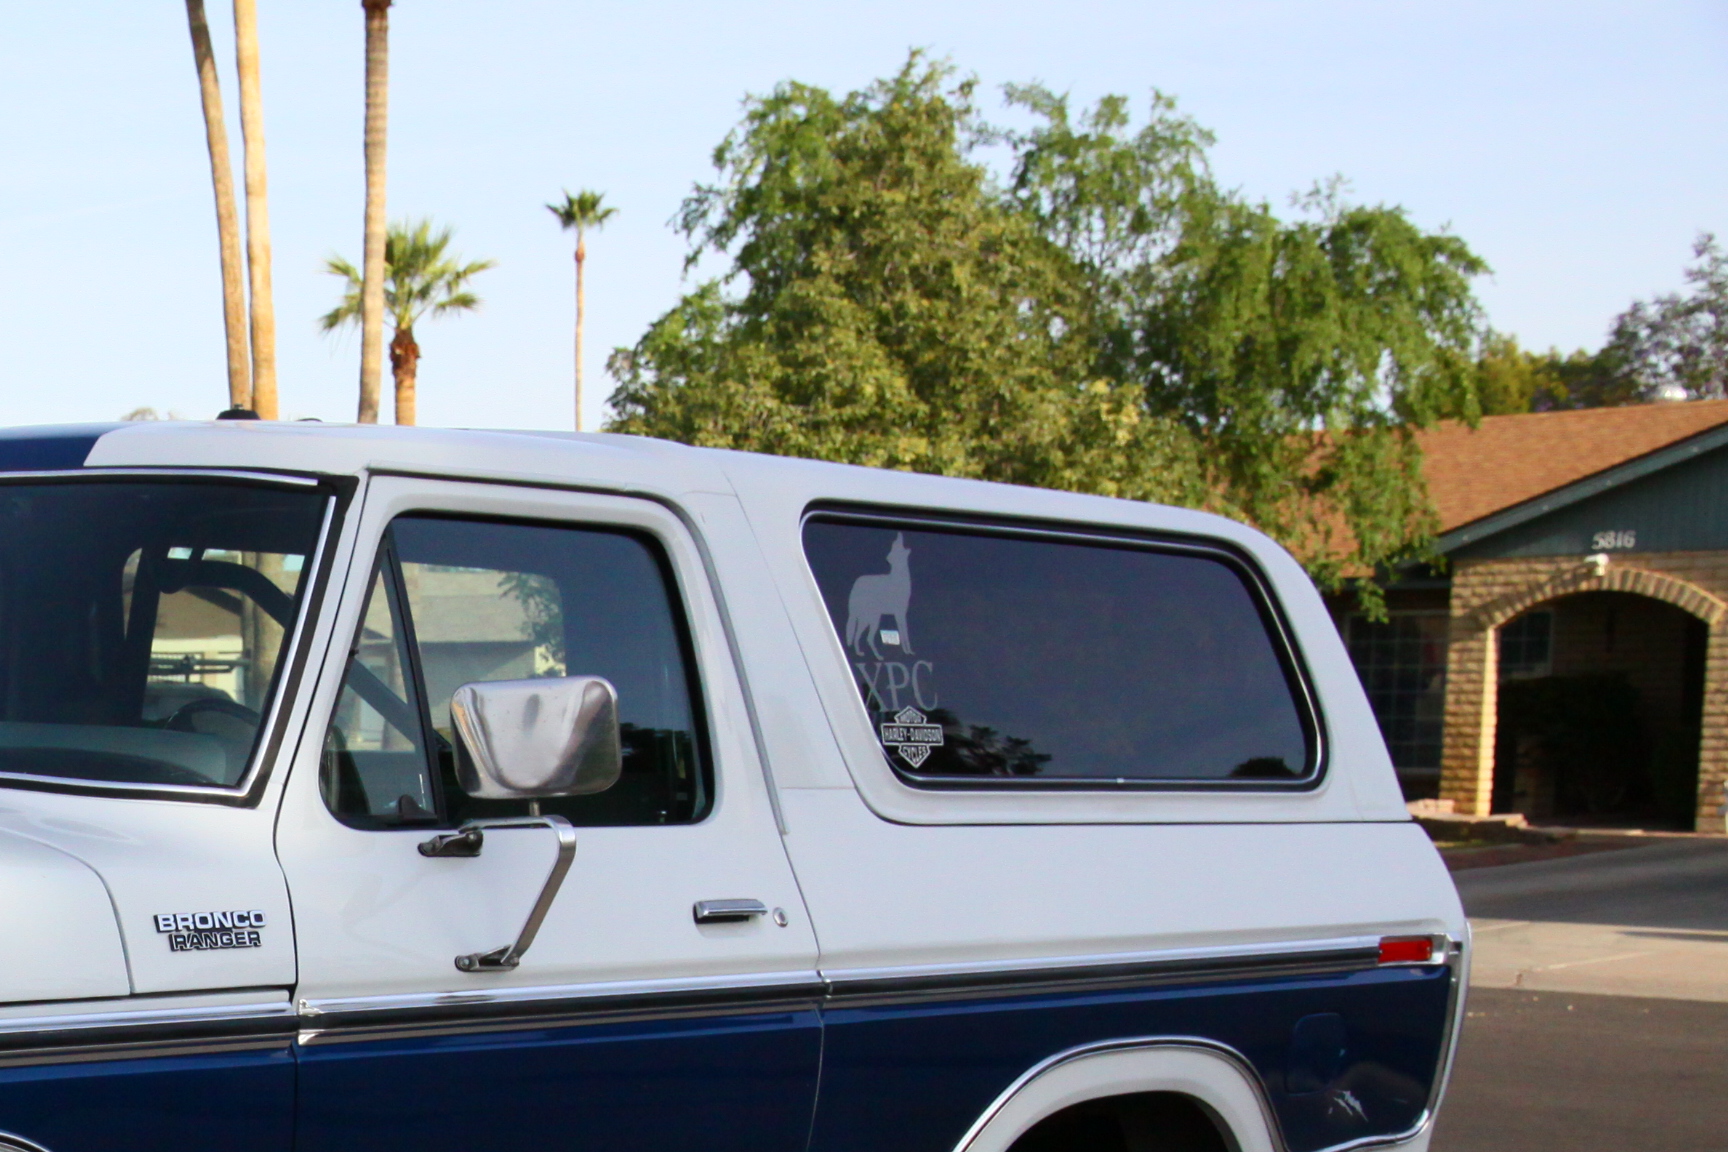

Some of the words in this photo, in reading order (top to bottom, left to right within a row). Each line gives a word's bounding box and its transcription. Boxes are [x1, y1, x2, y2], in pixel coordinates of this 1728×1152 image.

[1591, 530, 1636, 550] 5816
[855, 660, 938, 713] XPC
[882, 726, 941, 742] HARLEY-DAVIDSON
[153, 910, 266, 932] BRONCO
[168, 930, 262, 952] RANGER
